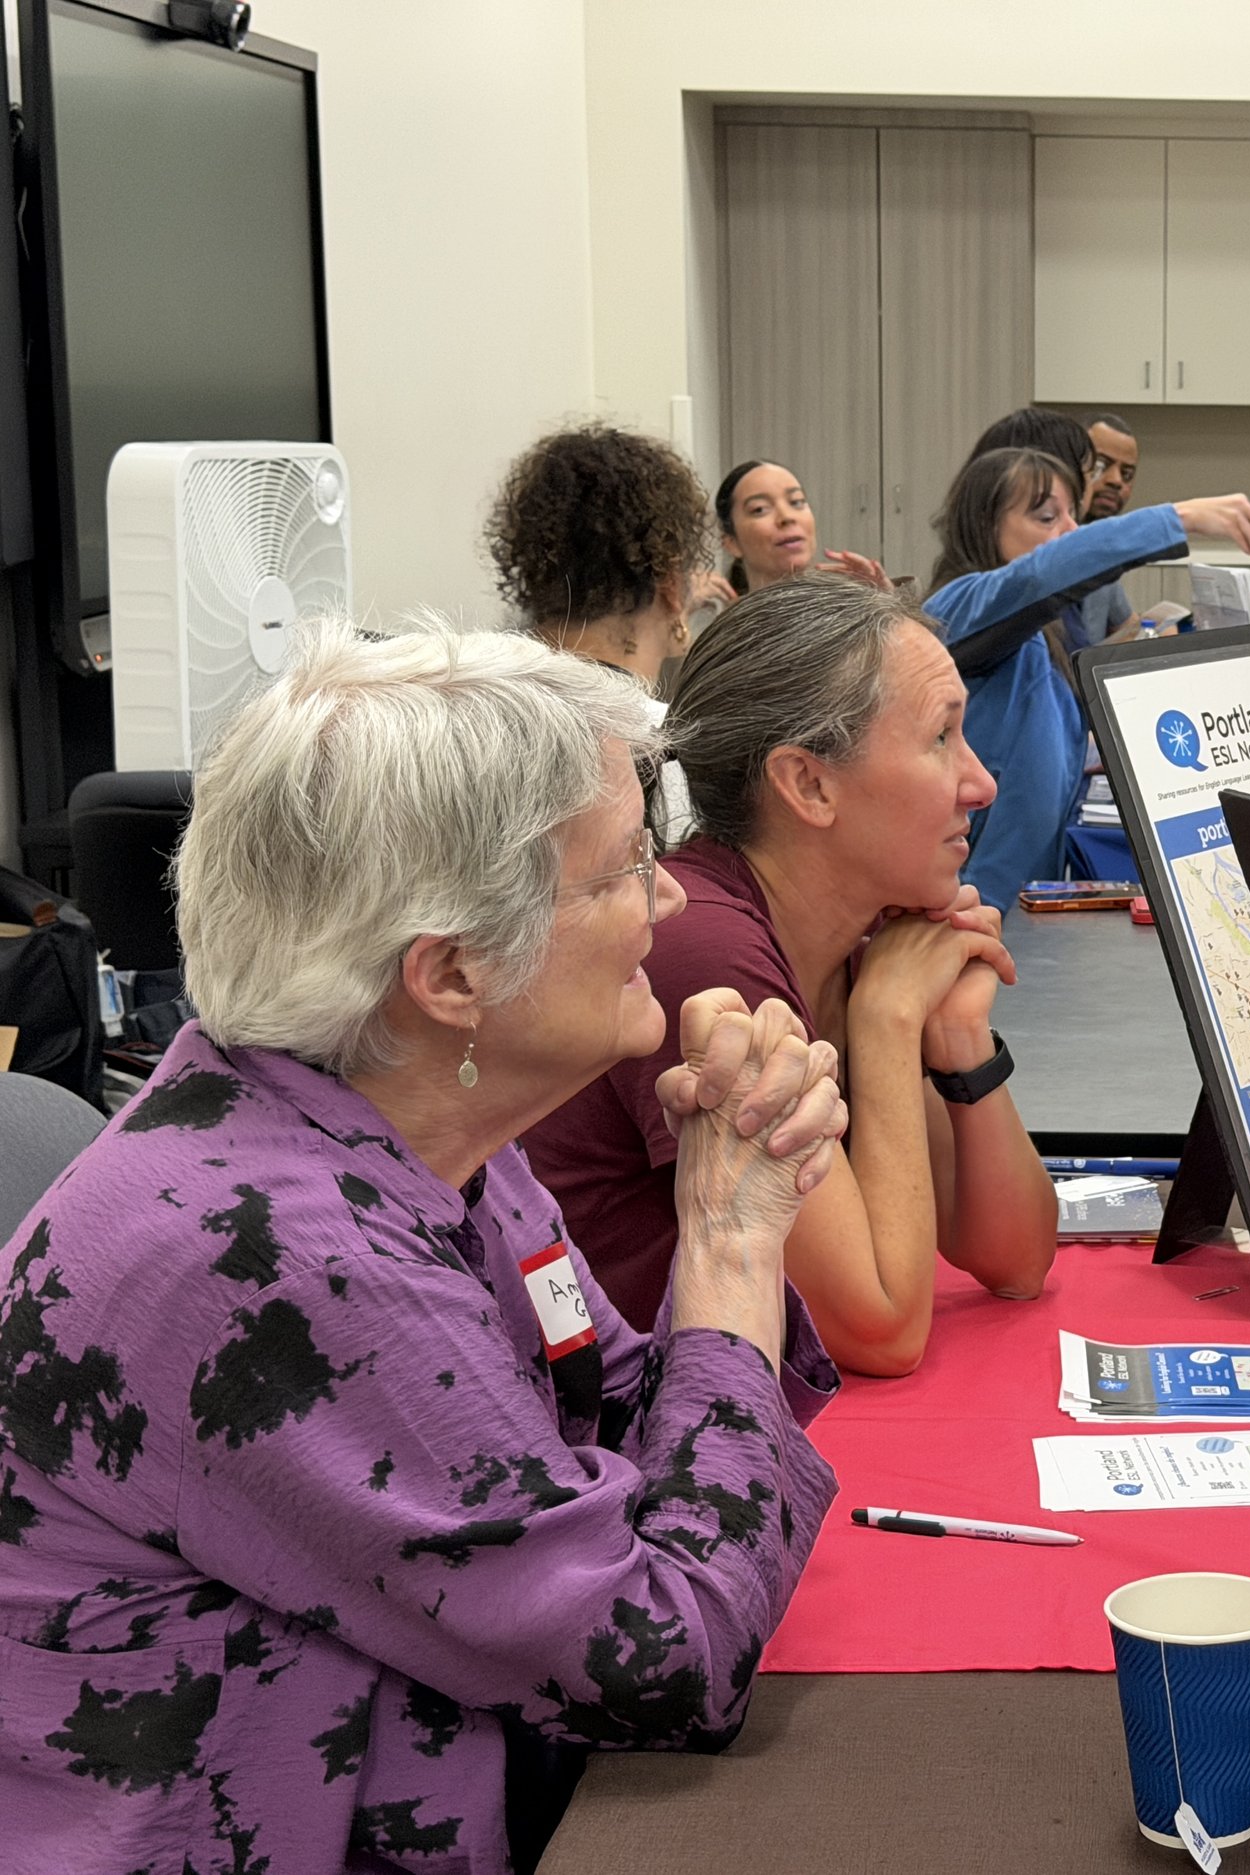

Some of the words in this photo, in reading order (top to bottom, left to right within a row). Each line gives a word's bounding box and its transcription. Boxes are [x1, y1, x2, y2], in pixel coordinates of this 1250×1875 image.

[1211, 744, 1238, 767] ESL
[1157, 791, 1176, 801] Sharing
[1176, 785, 1198, 796] resources
[1205, 779, 1220, 790] English
[1221, 775, 1241, 786] Language
[1197, 816, 1230, 848] port
[548, 1279, 580, 1303] Am
[1097, 1352, 1115, 1378] Portland
[1116, 1355, 1127, 1371] Network
[1118, 1371, 1129, 1380] ESL
[1096, 1450, 1124, 1481] Portland
[1118, 1449, 1134, 1471] Network
[1127, 1470, 1141, 1481] ESL
